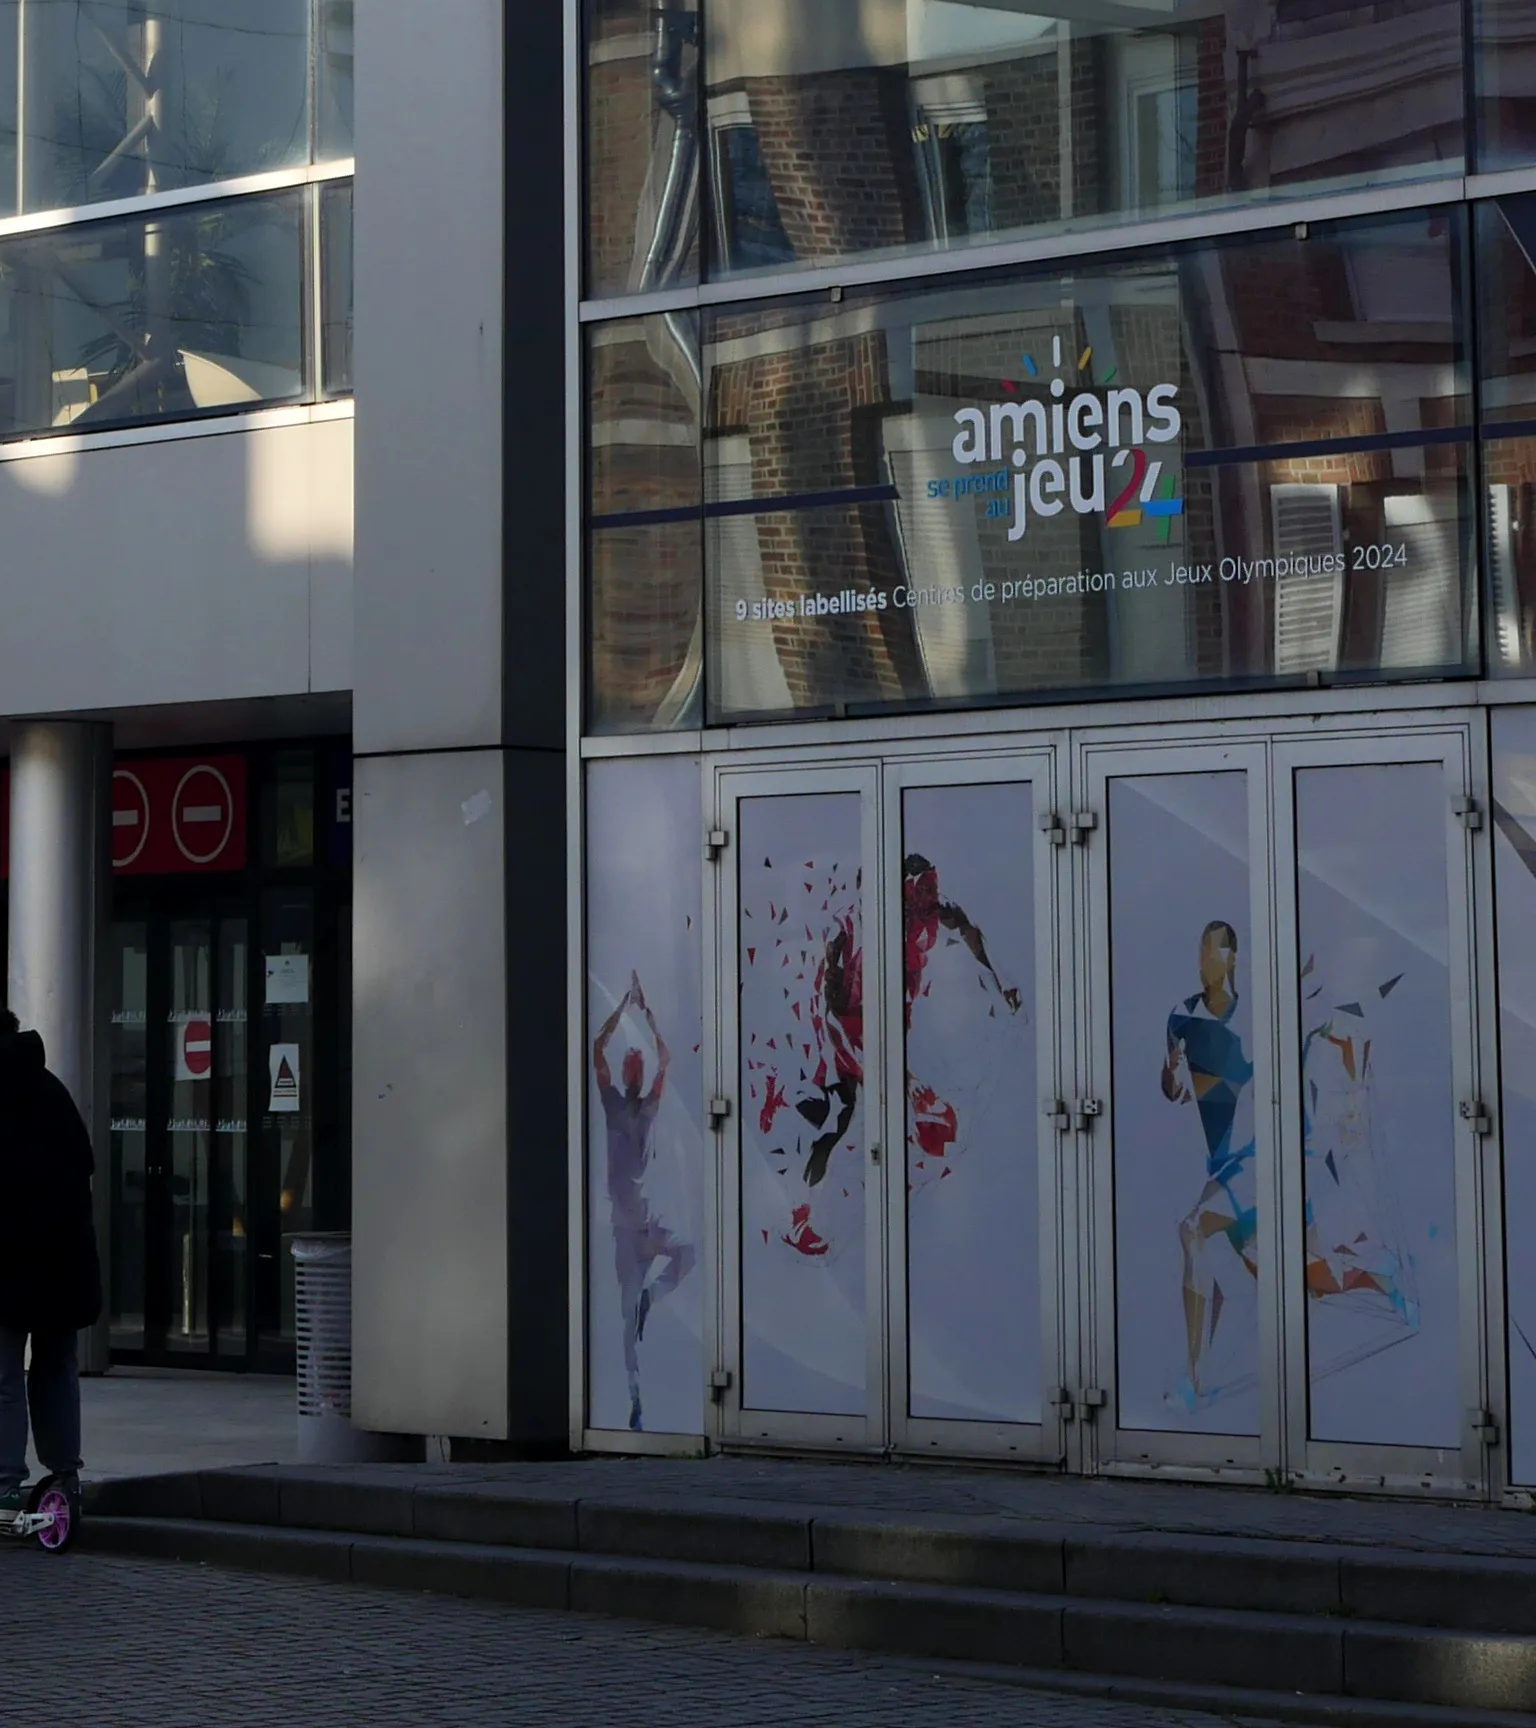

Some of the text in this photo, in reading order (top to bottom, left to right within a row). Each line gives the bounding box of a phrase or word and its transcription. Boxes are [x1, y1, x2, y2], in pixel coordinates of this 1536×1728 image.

[952, 379, 1181, 464] amiens
[928, 467, 1010, 500] se prend
[986, 499, 1011, 519] au
[735, 543, 1408, 621] 9 sites labellisés Centres de préparation aux Jeux Olympiques 2024
